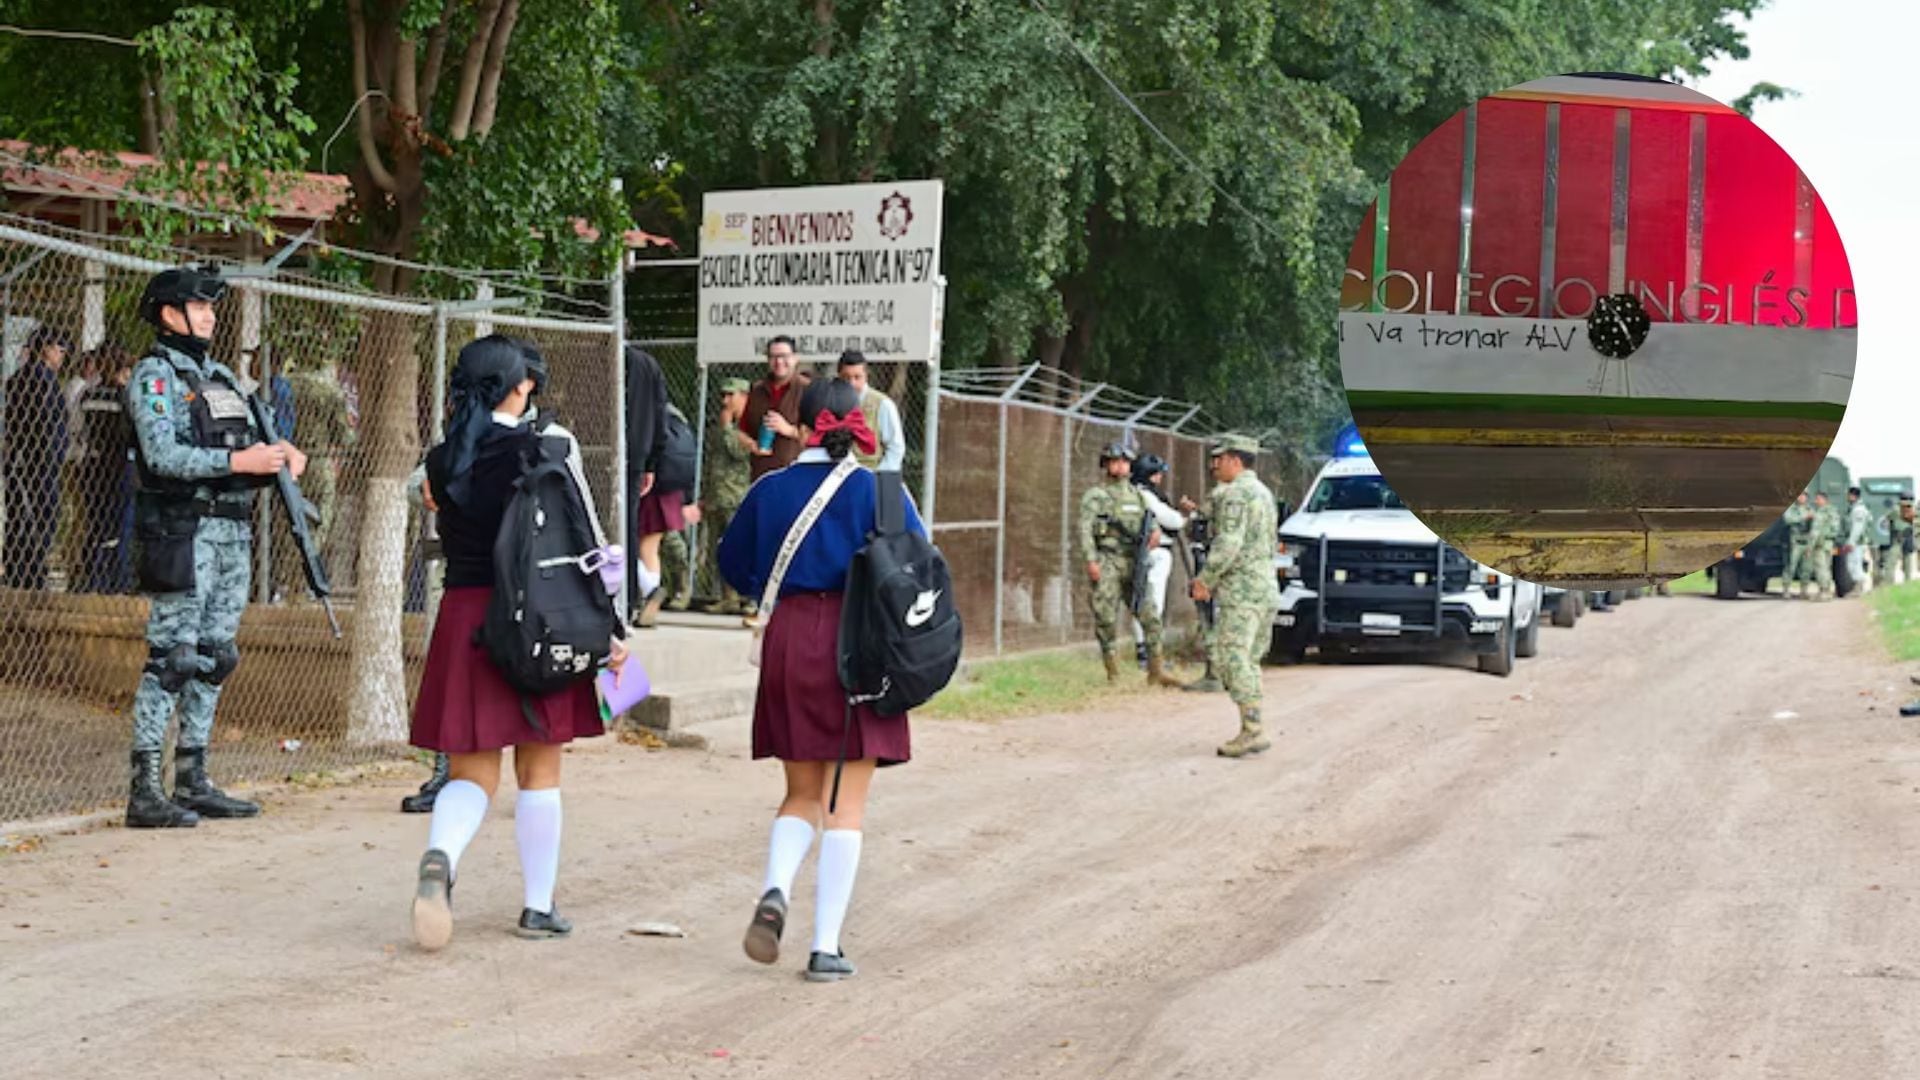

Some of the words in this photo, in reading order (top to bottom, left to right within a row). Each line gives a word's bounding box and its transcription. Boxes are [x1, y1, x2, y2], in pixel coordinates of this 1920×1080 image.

[724, 213, 747, 229] SEP
[752, 210, 854, 246] BIENVENIDOS
[702, 252, 750, 288] ESCUELA
[753, 251, 833, 286] SECUNDARIA
[835, 249, 891, 285] TECNICA
[709, 303, 743, 327] CLAVE
[1417, 319, 1511, 349] tronar
[1524, 323, 1577, 352] ALV
